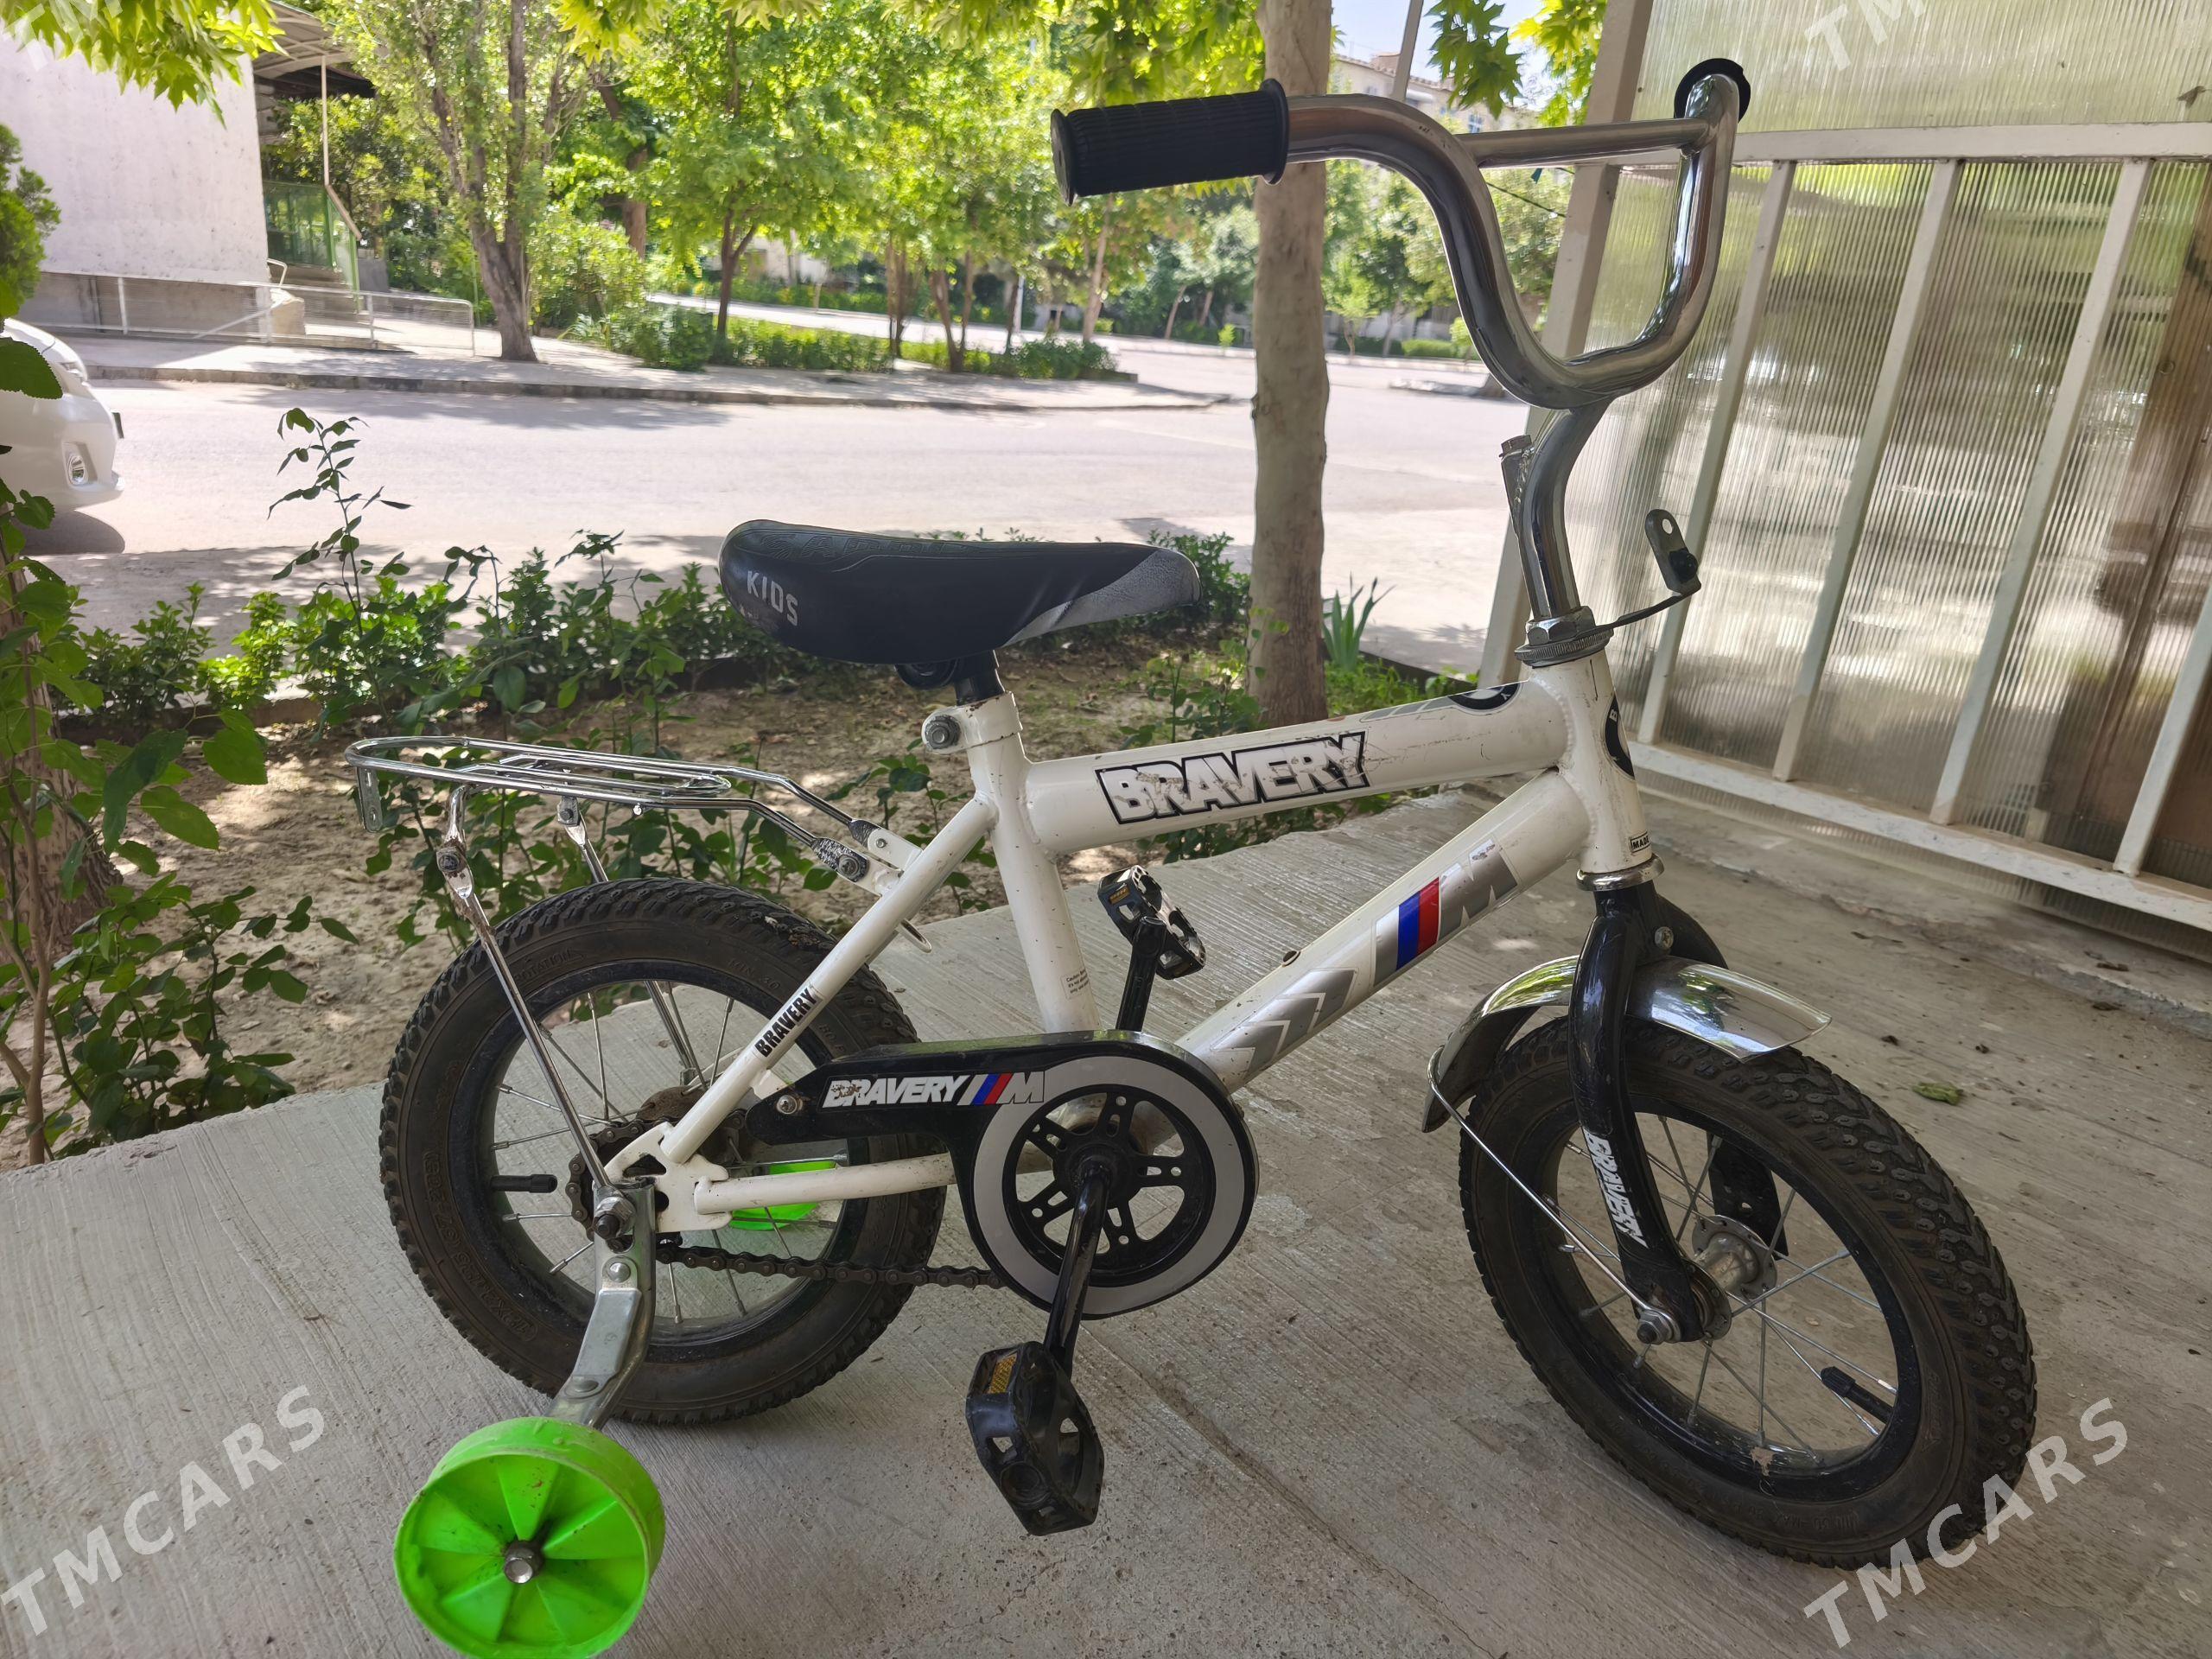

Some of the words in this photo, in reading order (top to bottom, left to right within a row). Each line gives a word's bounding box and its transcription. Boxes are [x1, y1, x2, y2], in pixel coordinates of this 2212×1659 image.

[747, 570, 798, 626] KIDS
[1095, 731, 1370, 824] BRAVERY
[754, 988, 817, 1058] BRAVERY
[822, 1074, 971, 1109] BRAVERY
[1581, 1126, 1649, 1249] BRAVERY
